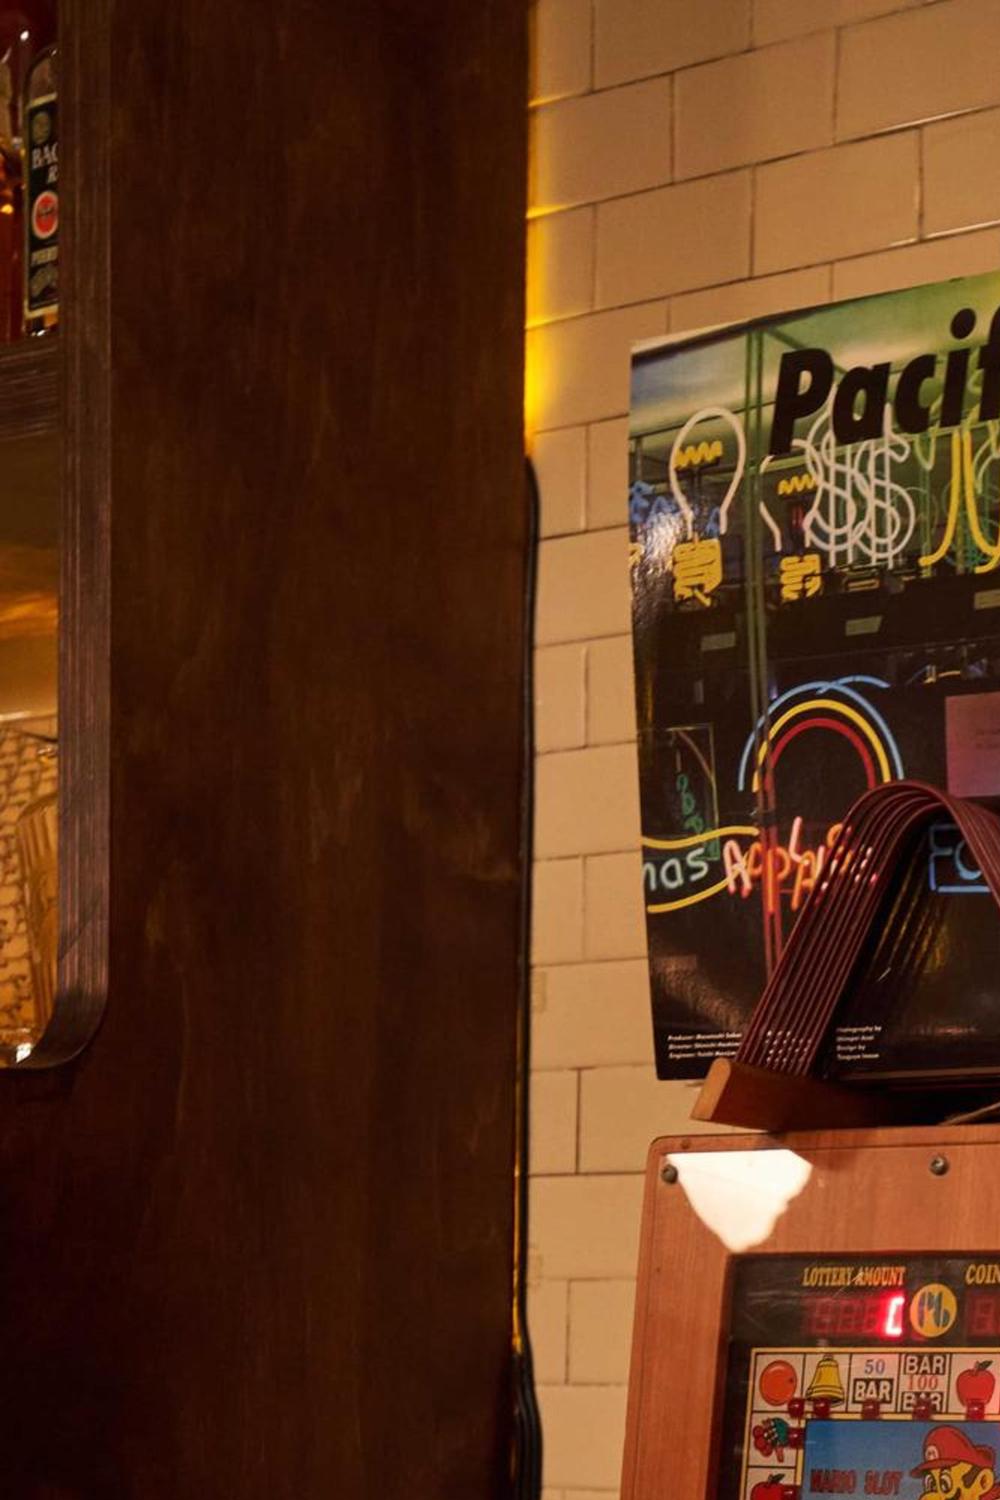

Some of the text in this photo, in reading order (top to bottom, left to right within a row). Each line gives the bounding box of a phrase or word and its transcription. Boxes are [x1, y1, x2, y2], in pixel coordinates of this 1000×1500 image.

[803, 1266, 906, 1287] LOTTERY AMOUNT
[864, 1359, 886, 1375] 50
[905, 1355, 945, 1374] BAR
[854, 1380, 892, 1402] BAR
[907, 1374, 939, 1391] 100
[863, 1469, 904, 1496] SLOT
